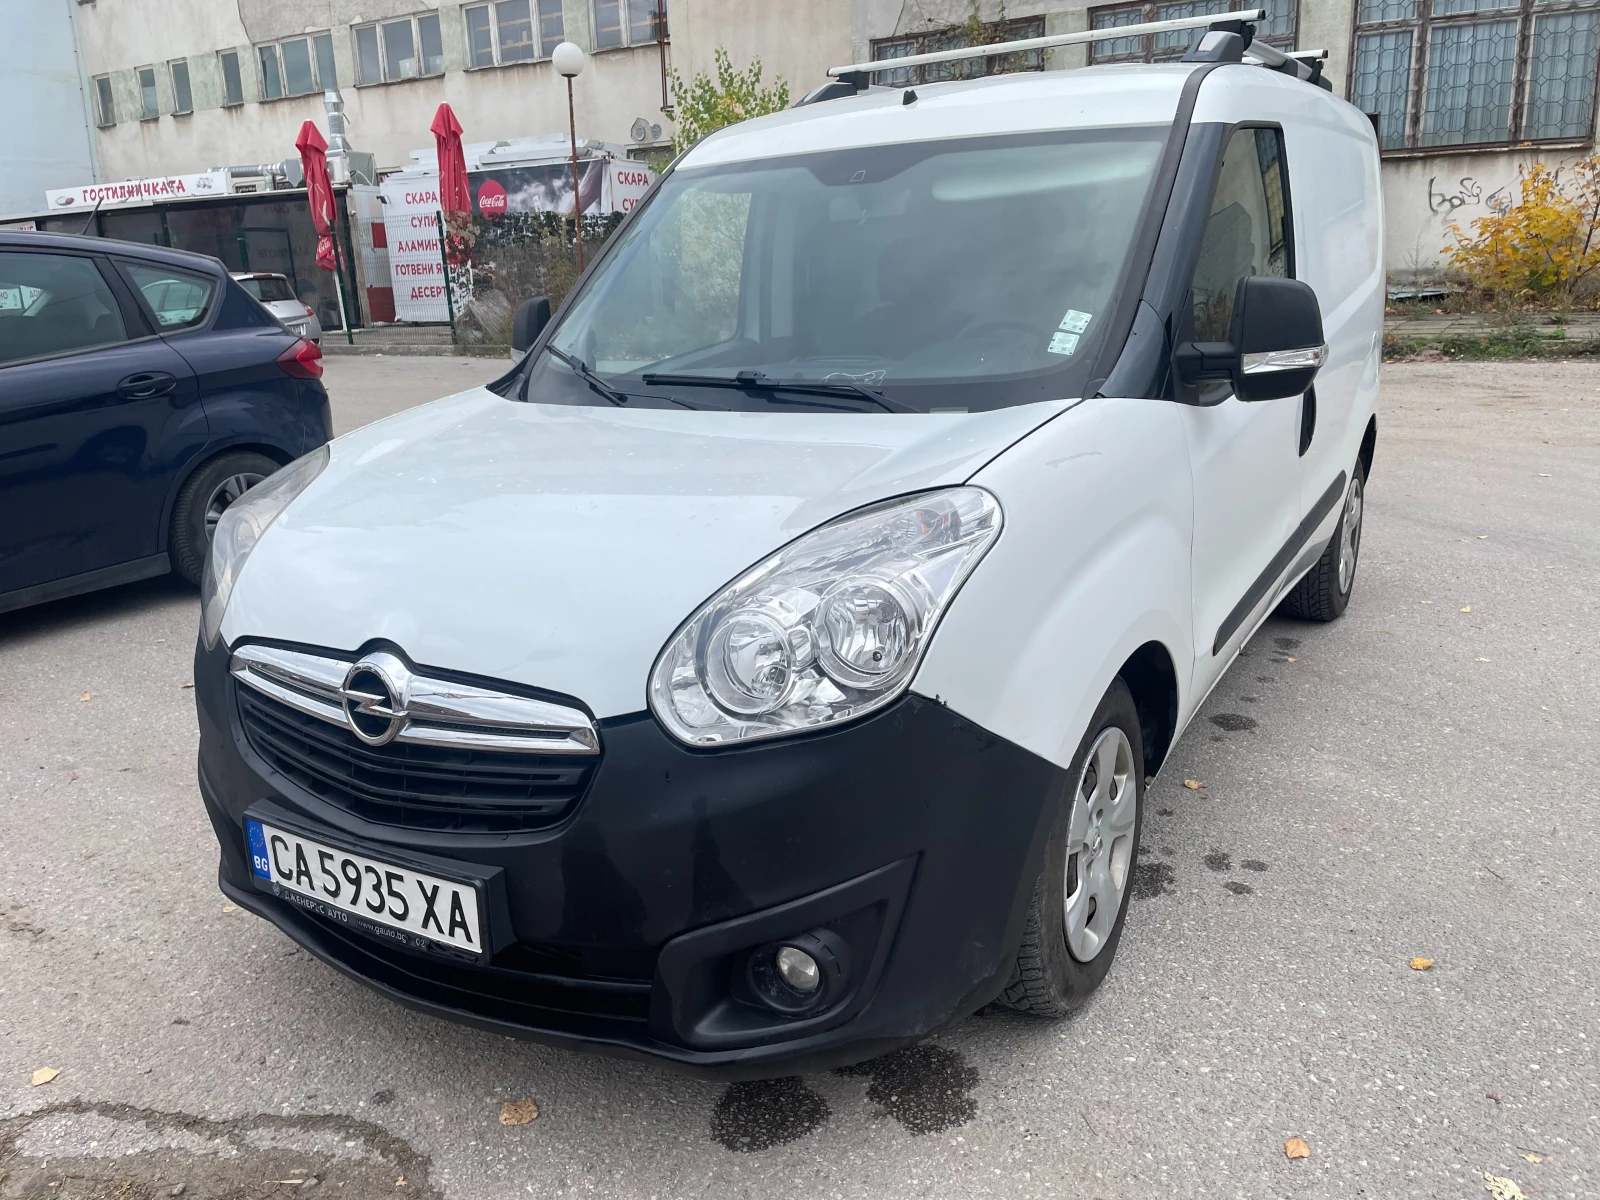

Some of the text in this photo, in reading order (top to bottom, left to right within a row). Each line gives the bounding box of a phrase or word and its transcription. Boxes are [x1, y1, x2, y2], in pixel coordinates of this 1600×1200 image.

[617, 171, 650, 187] СКАРА
[82, 179, 186, 202] ГОСТИЛНИЧКАТА
[405, 191, 438, 205] СКАРА
[411, 215, 438, 228] СУПИ
[398, 239, 441, 252] АЛАМИН
[395, 263, 434, 275] ГОТВЕНИ
[254, 855, 268, 872] BG
[328, 908, 348, 922] АУТО
